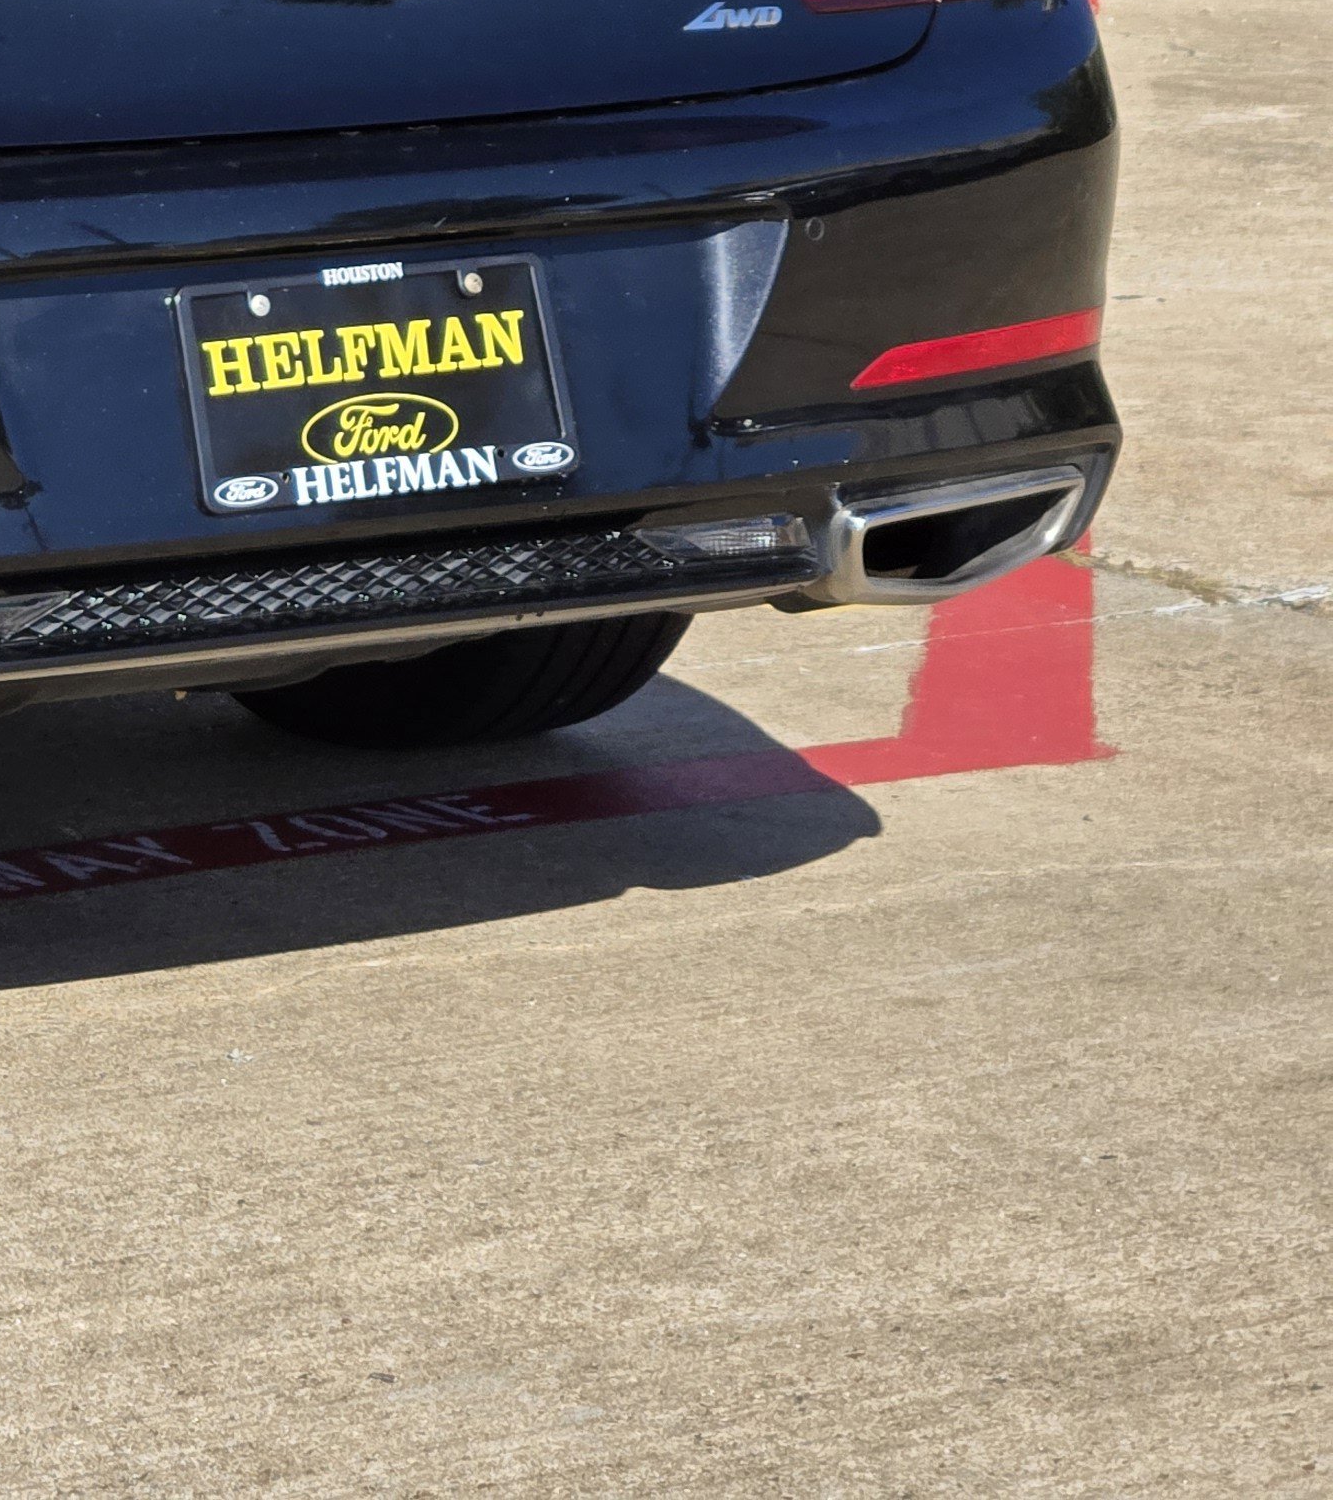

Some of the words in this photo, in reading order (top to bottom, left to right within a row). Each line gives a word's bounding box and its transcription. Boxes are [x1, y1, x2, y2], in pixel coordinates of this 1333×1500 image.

[321, 262, 404, 285] HOUSTON
[201, 309, 525, 396] HELFMAN
[333, 403, 426, 457] Ford
[293, 445, 499, 506] HELFMAN
[524, 449, 565, 466] Ford
[226, 483, 267, 501] Ford
[213, 794, 533, 853] ZONE
